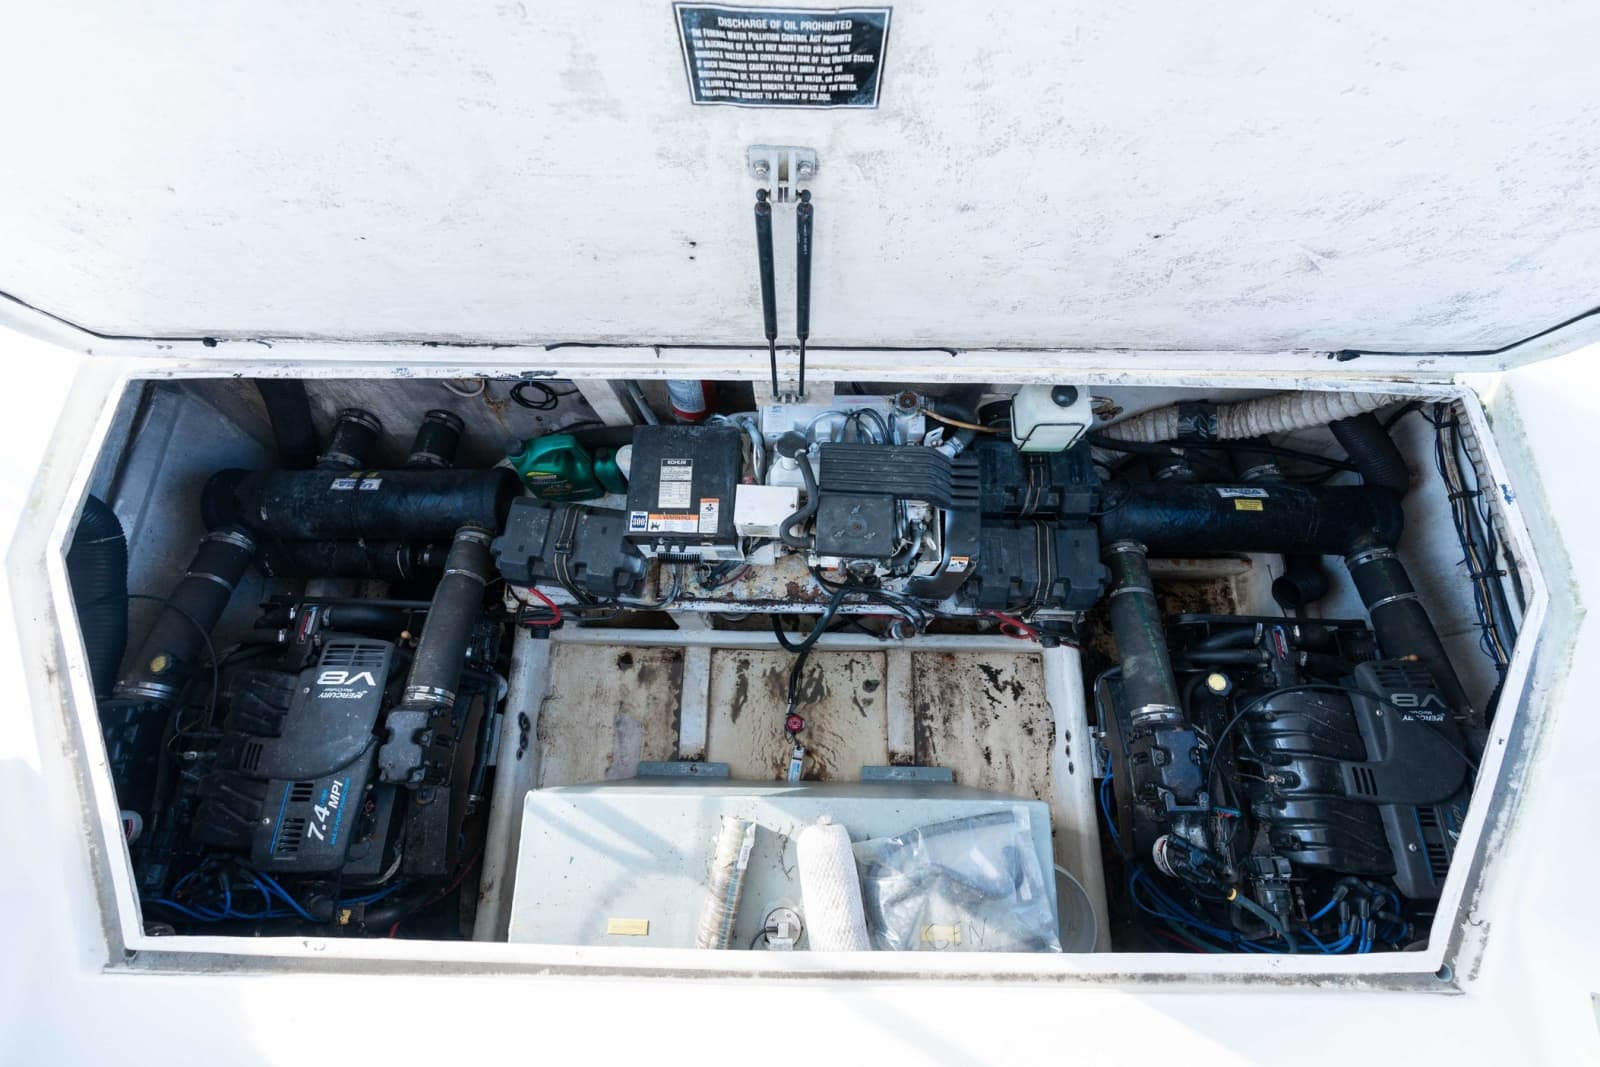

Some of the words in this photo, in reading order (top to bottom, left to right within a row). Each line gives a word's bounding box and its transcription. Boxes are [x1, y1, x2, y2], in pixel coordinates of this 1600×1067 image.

[718, 16, 768, 29] DISCHARGE
[770, 19, 781, 29] OF
[784, 20, 798, 29] OIL
[800, 20, 852, 31] PROHIBITED
[727, 31, 747, 40] WATER
[748, 32, 780, 42] POLLUTION
[781, 33, 807, 42] CONTROL
[809, 34, 821, 42] ACT
[705, 40, 734, 50] DISCHARGE
[735, 42, 744, 50] OF
[744, 43, 754, 51] OIL
[755, 43, 764, 52] OR
[822, 45, 838, 54] UPON
[840, 44, 850, 52] THE
[748, 53, 758, 61] AND
[812, 56, 819, 64] OF
[820, 56, 830, 64] THE
[317, 671, 376, 686] V8
[318, 690, 367, 699] MERCURY
[1391, 693, 1446, 708] V8
[328, 780, 343, 808] MPI
[307, 804, 330, 840] 7.4
